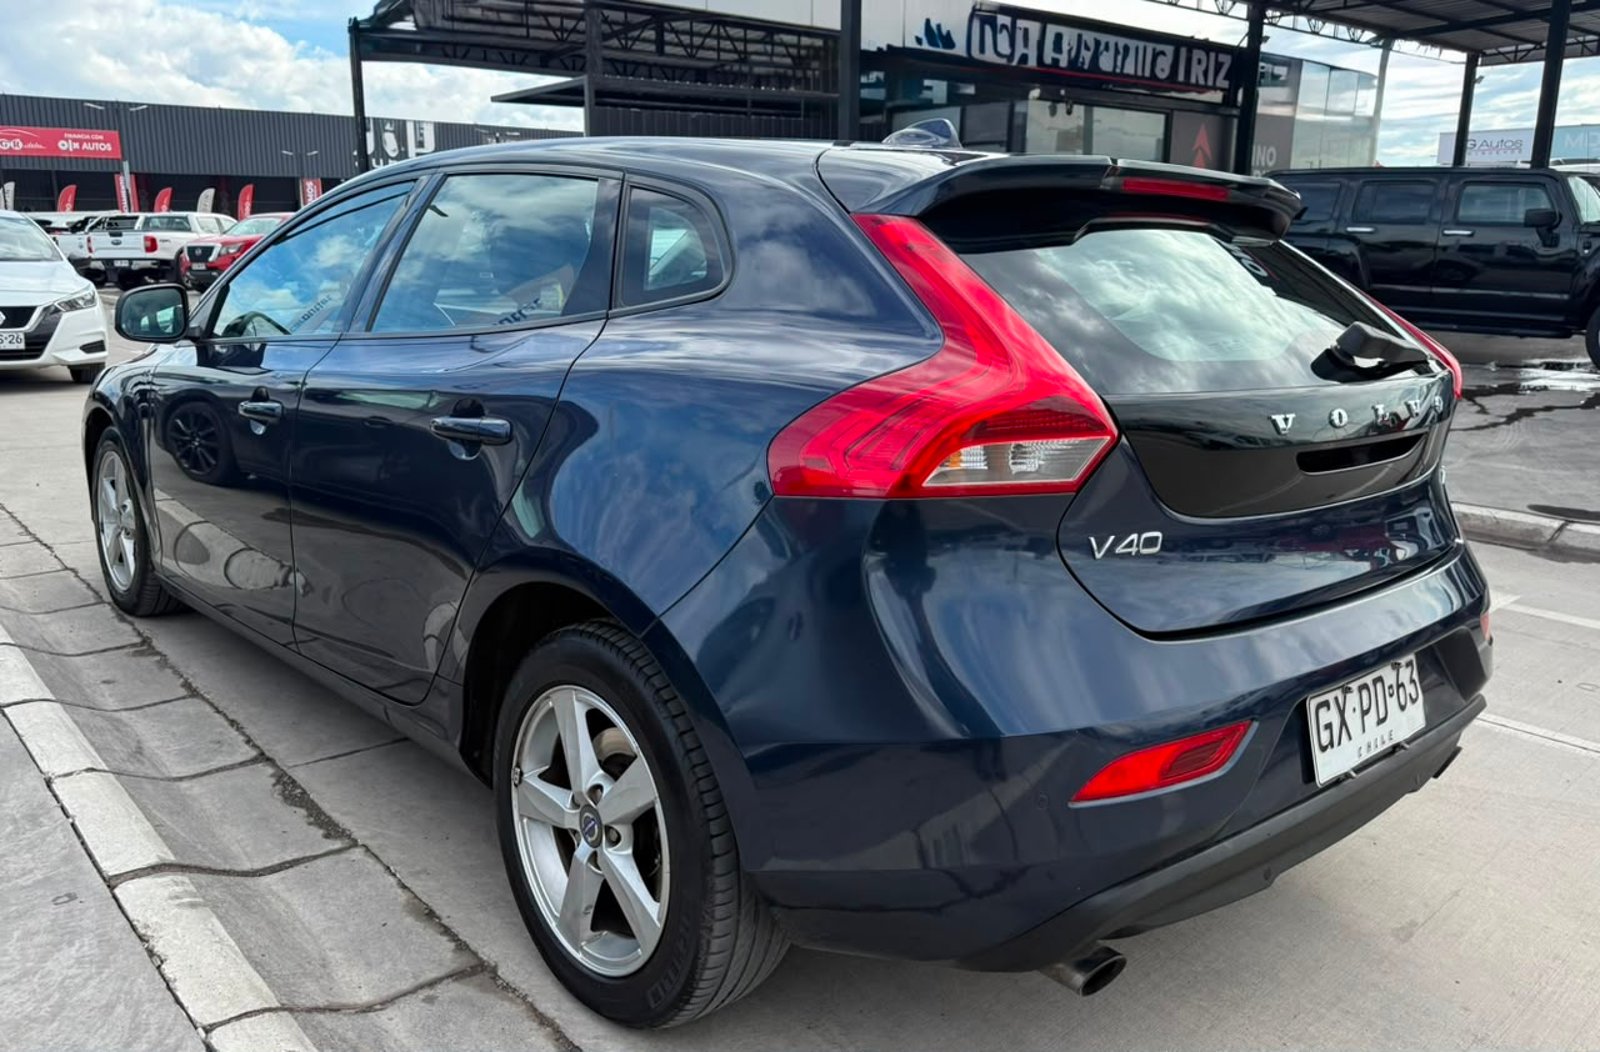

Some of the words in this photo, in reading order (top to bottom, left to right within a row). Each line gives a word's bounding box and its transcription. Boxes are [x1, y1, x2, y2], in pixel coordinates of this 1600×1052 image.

[81, 142, 112, 151] AUTOS
[1270, 395, 1444, 435] VOLVO
[1088, 531, 1163, 560] V40
